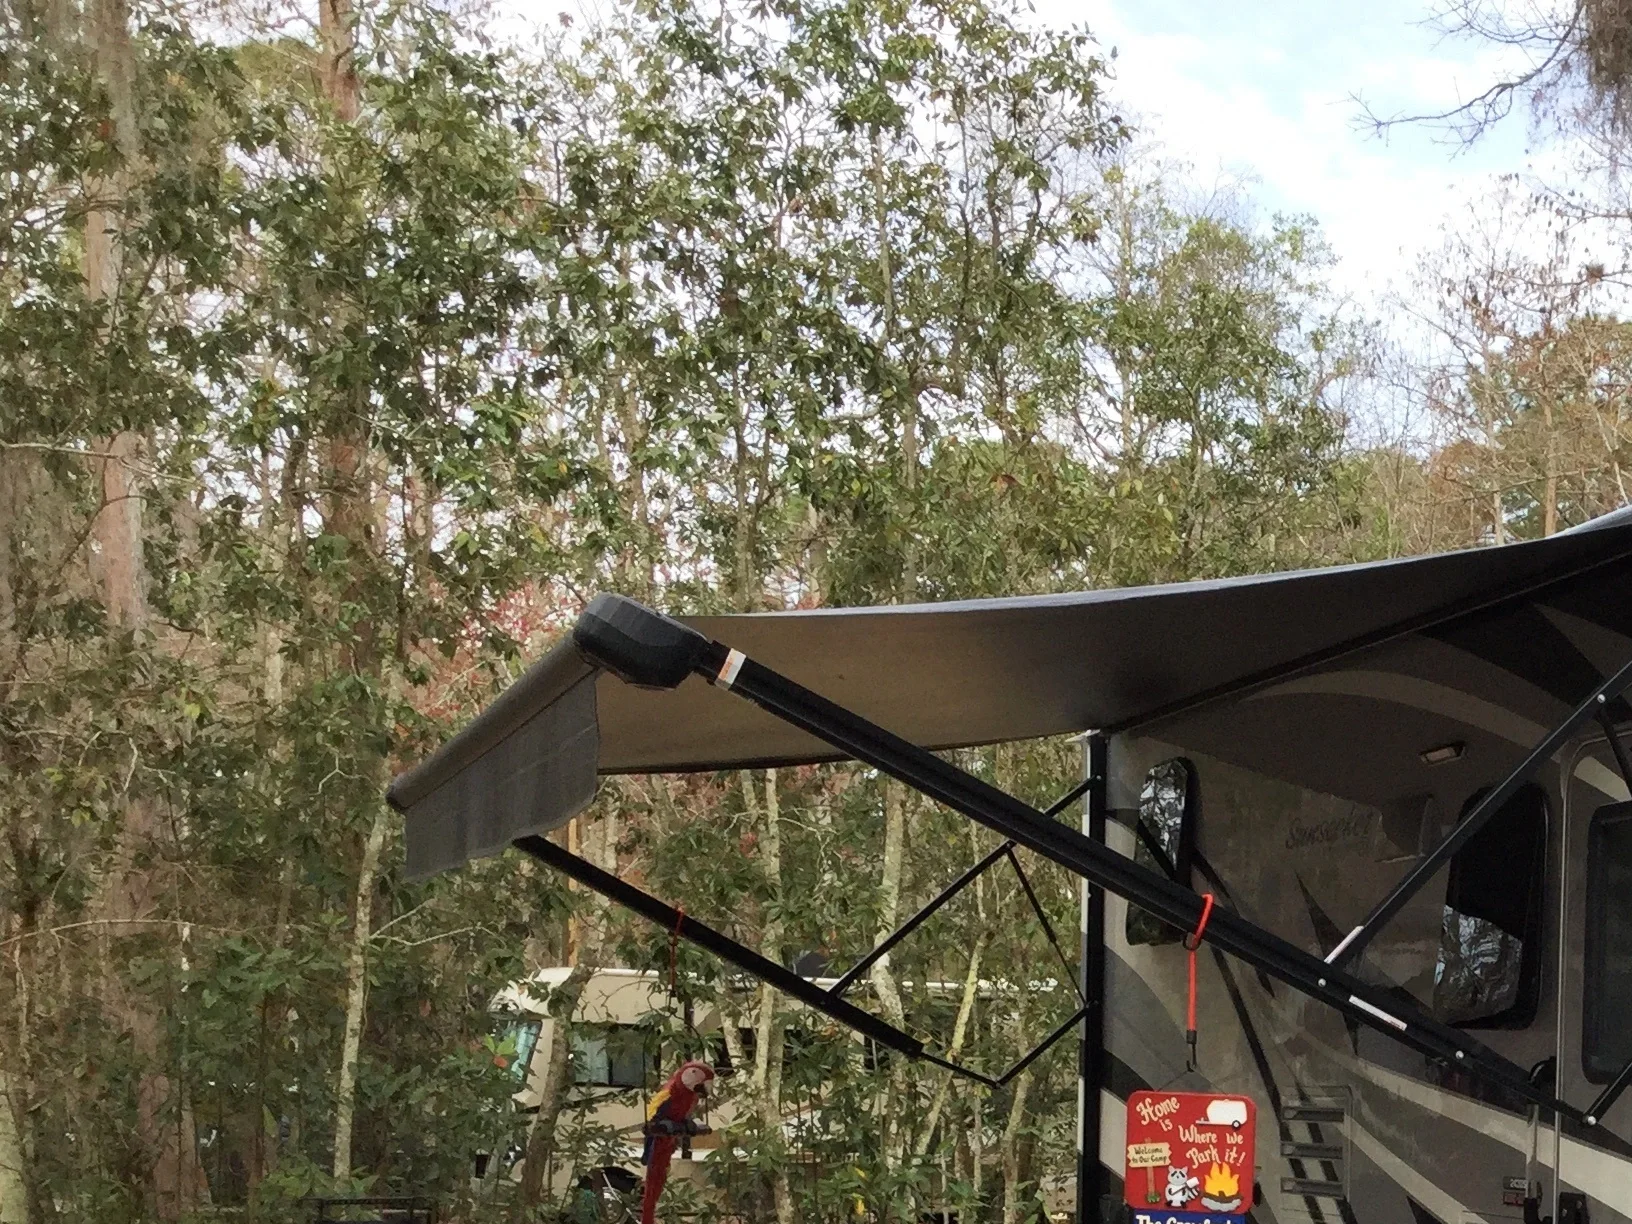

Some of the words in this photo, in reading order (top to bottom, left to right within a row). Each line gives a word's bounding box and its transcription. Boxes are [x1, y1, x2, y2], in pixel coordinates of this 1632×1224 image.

[1136, 1097, 1180, 1126] Home
[1159, 1118, 1173, 1132] is
[1178, 1124, 1218, 1144] Where
[1186, 1145, 1223, 1169] Park
